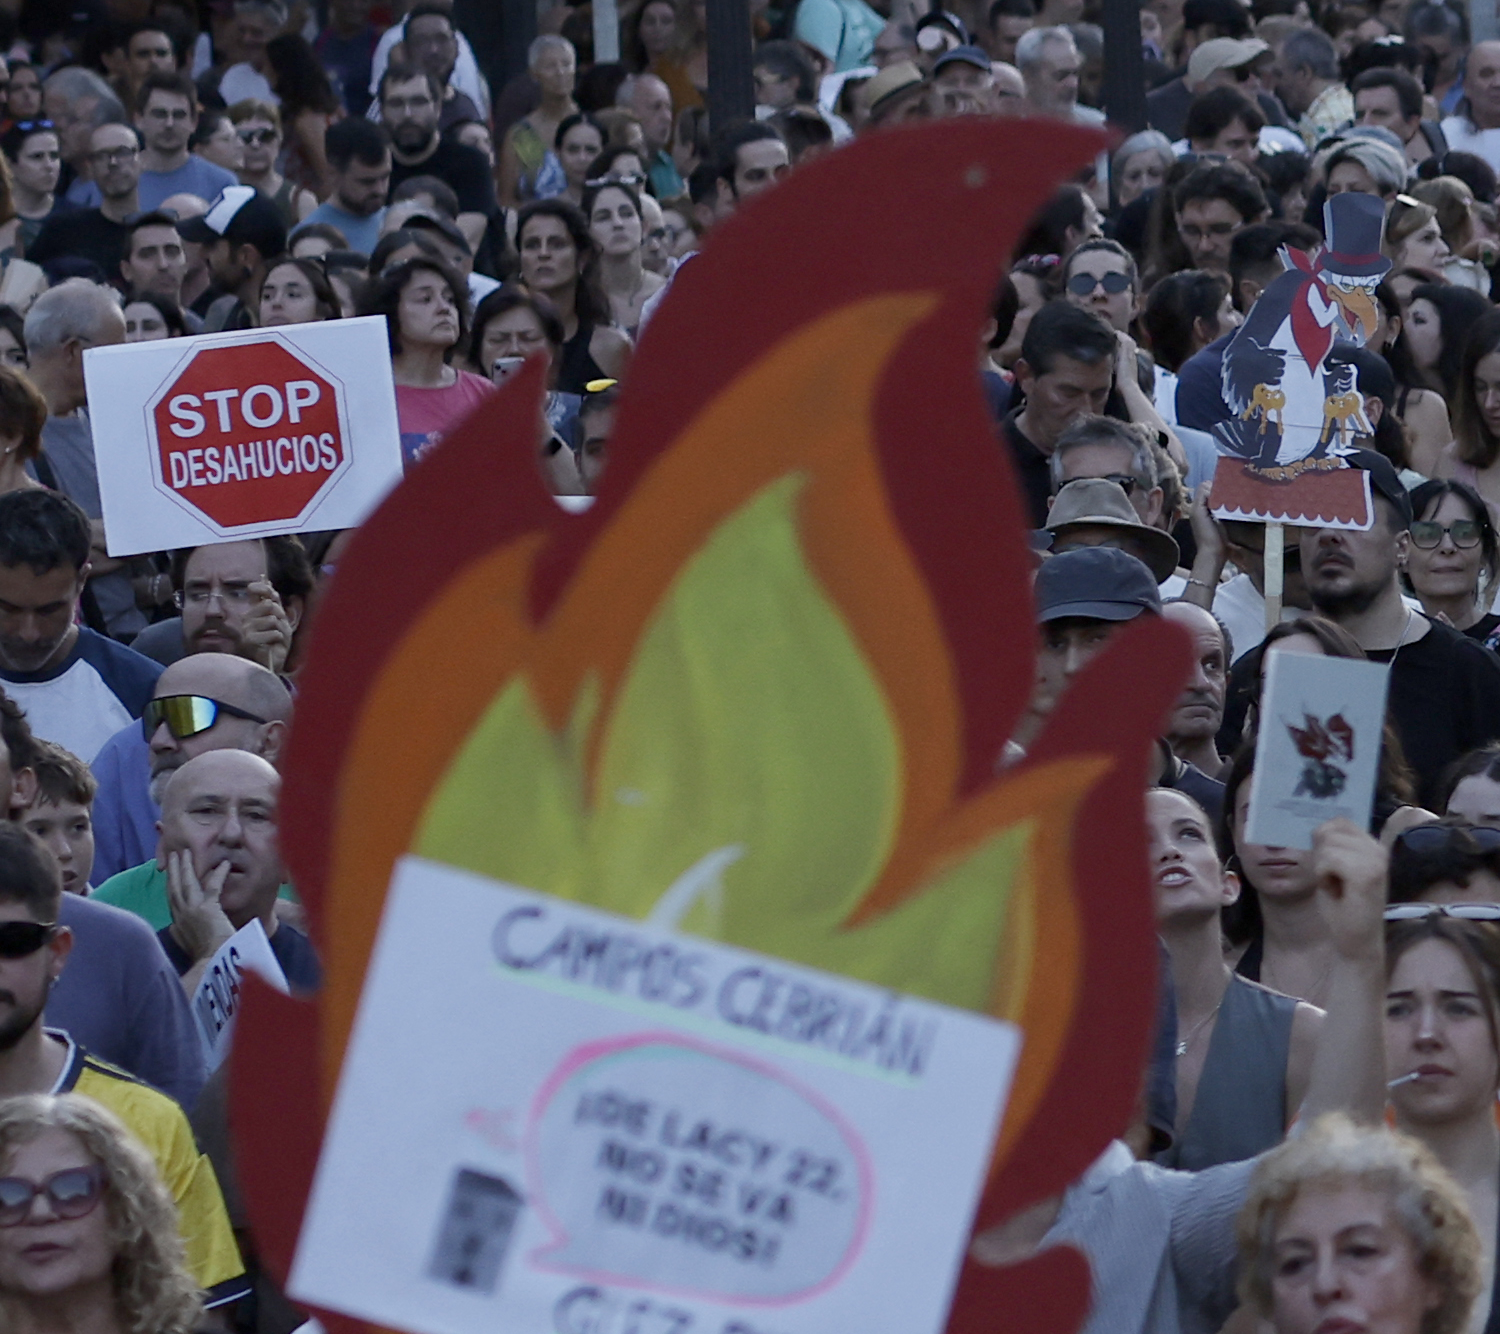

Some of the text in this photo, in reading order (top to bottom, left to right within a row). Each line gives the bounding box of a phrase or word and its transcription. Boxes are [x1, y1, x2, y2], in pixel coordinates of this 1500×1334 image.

[172, 380, 321, 438] STOP
[172, 434, 338, 490] DESAHUCIOS
[493, 906, 710, 1007] CAMPOS
[660, 1112, 775, 1172] LACY
[598, 1140, 796, 1223] NO SE VA
[598, 1186, 783, 1267] NI DIOS!
